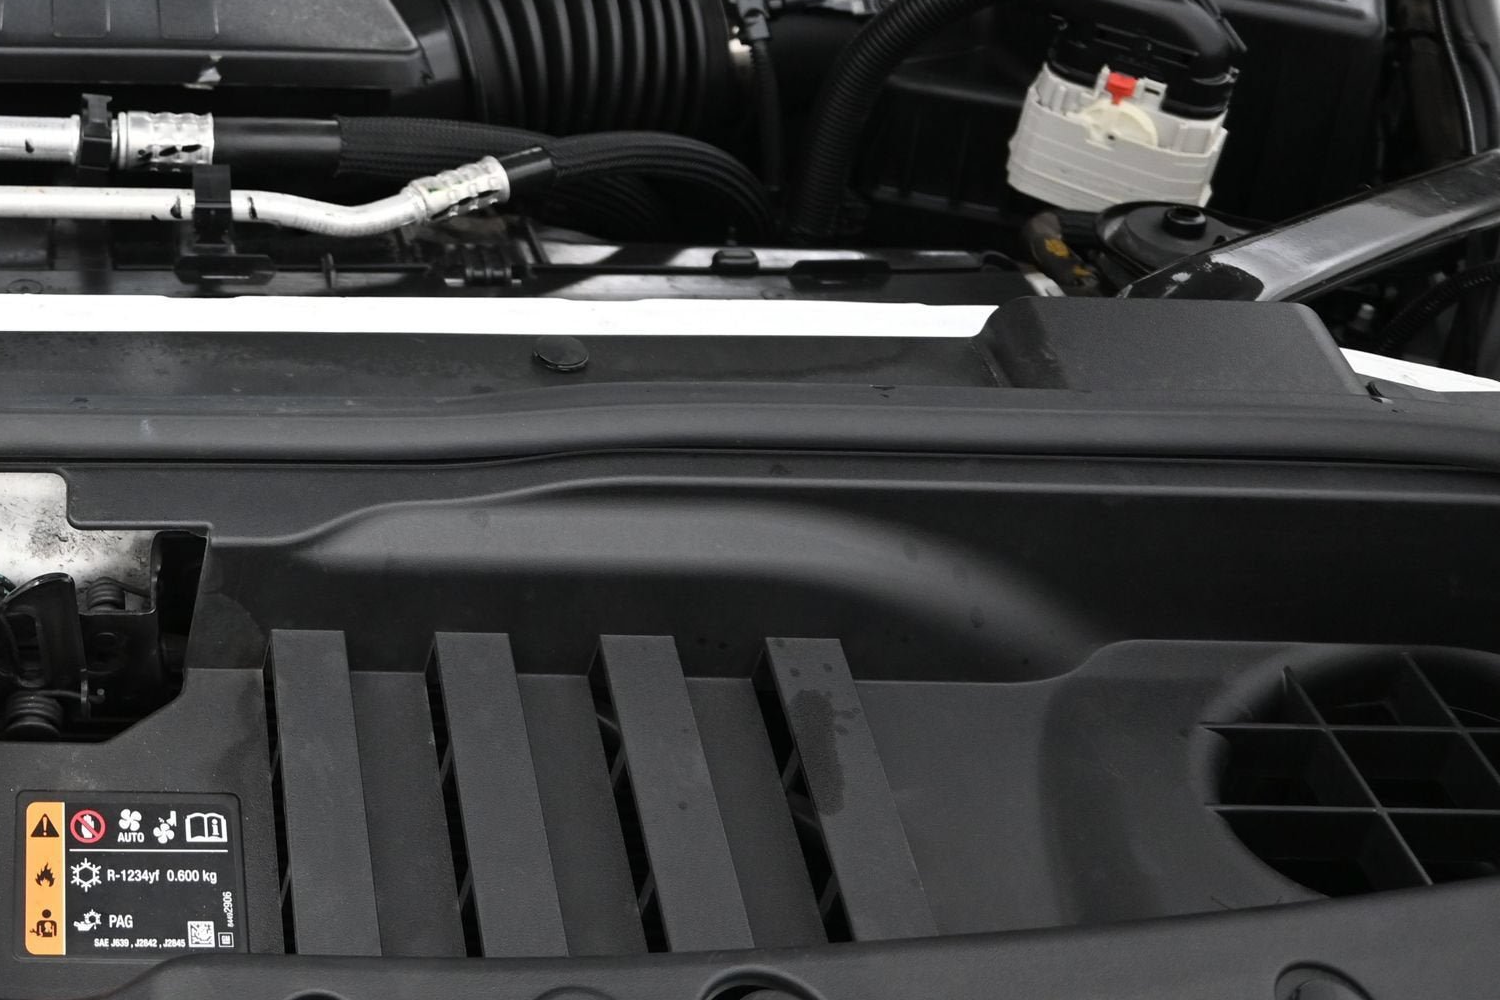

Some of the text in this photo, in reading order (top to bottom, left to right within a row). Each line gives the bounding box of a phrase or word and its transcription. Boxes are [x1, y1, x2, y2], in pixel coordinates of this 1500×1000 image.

[117, 832, 145, 843] AUTO
[106, 869, 218, 885] R-1234yf 0.600 kg
[108, 914, 134, 929] PAG
[93, 938, 109, 948] SAE
[162, 938, 186, 948] J2845
